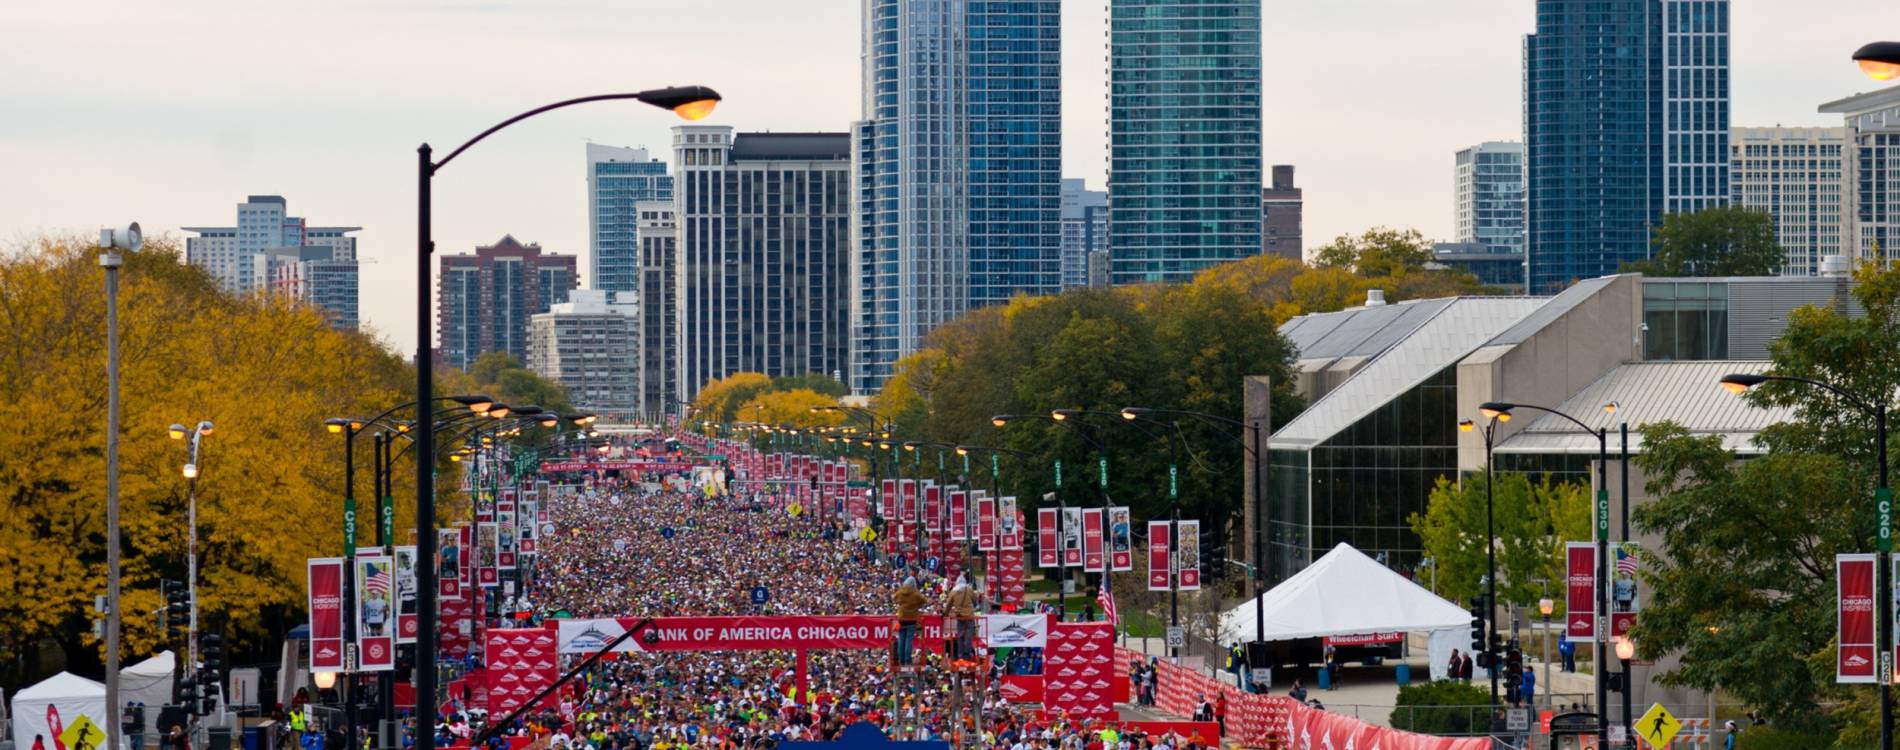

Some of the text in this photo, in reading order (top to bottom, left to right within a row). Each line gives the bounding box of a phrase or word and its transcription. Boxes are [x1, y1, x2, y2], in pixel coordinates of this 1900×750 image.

[344, 510, 355, 544] C31
[383, 506, 392, 535] C41
[1599, 500, 1608, 530] C30
[1878, 500, 1890, 539] C20
[693, 628, 714, 641] OF
[718, 626, 793, 641] AMERICA
[797, 626, 869, 640] CHICAGO
[1169, 637, 1182, 646] 30
[1376, 632, 1399, 641] Start
[1881, 653, 1890, 683] C20
